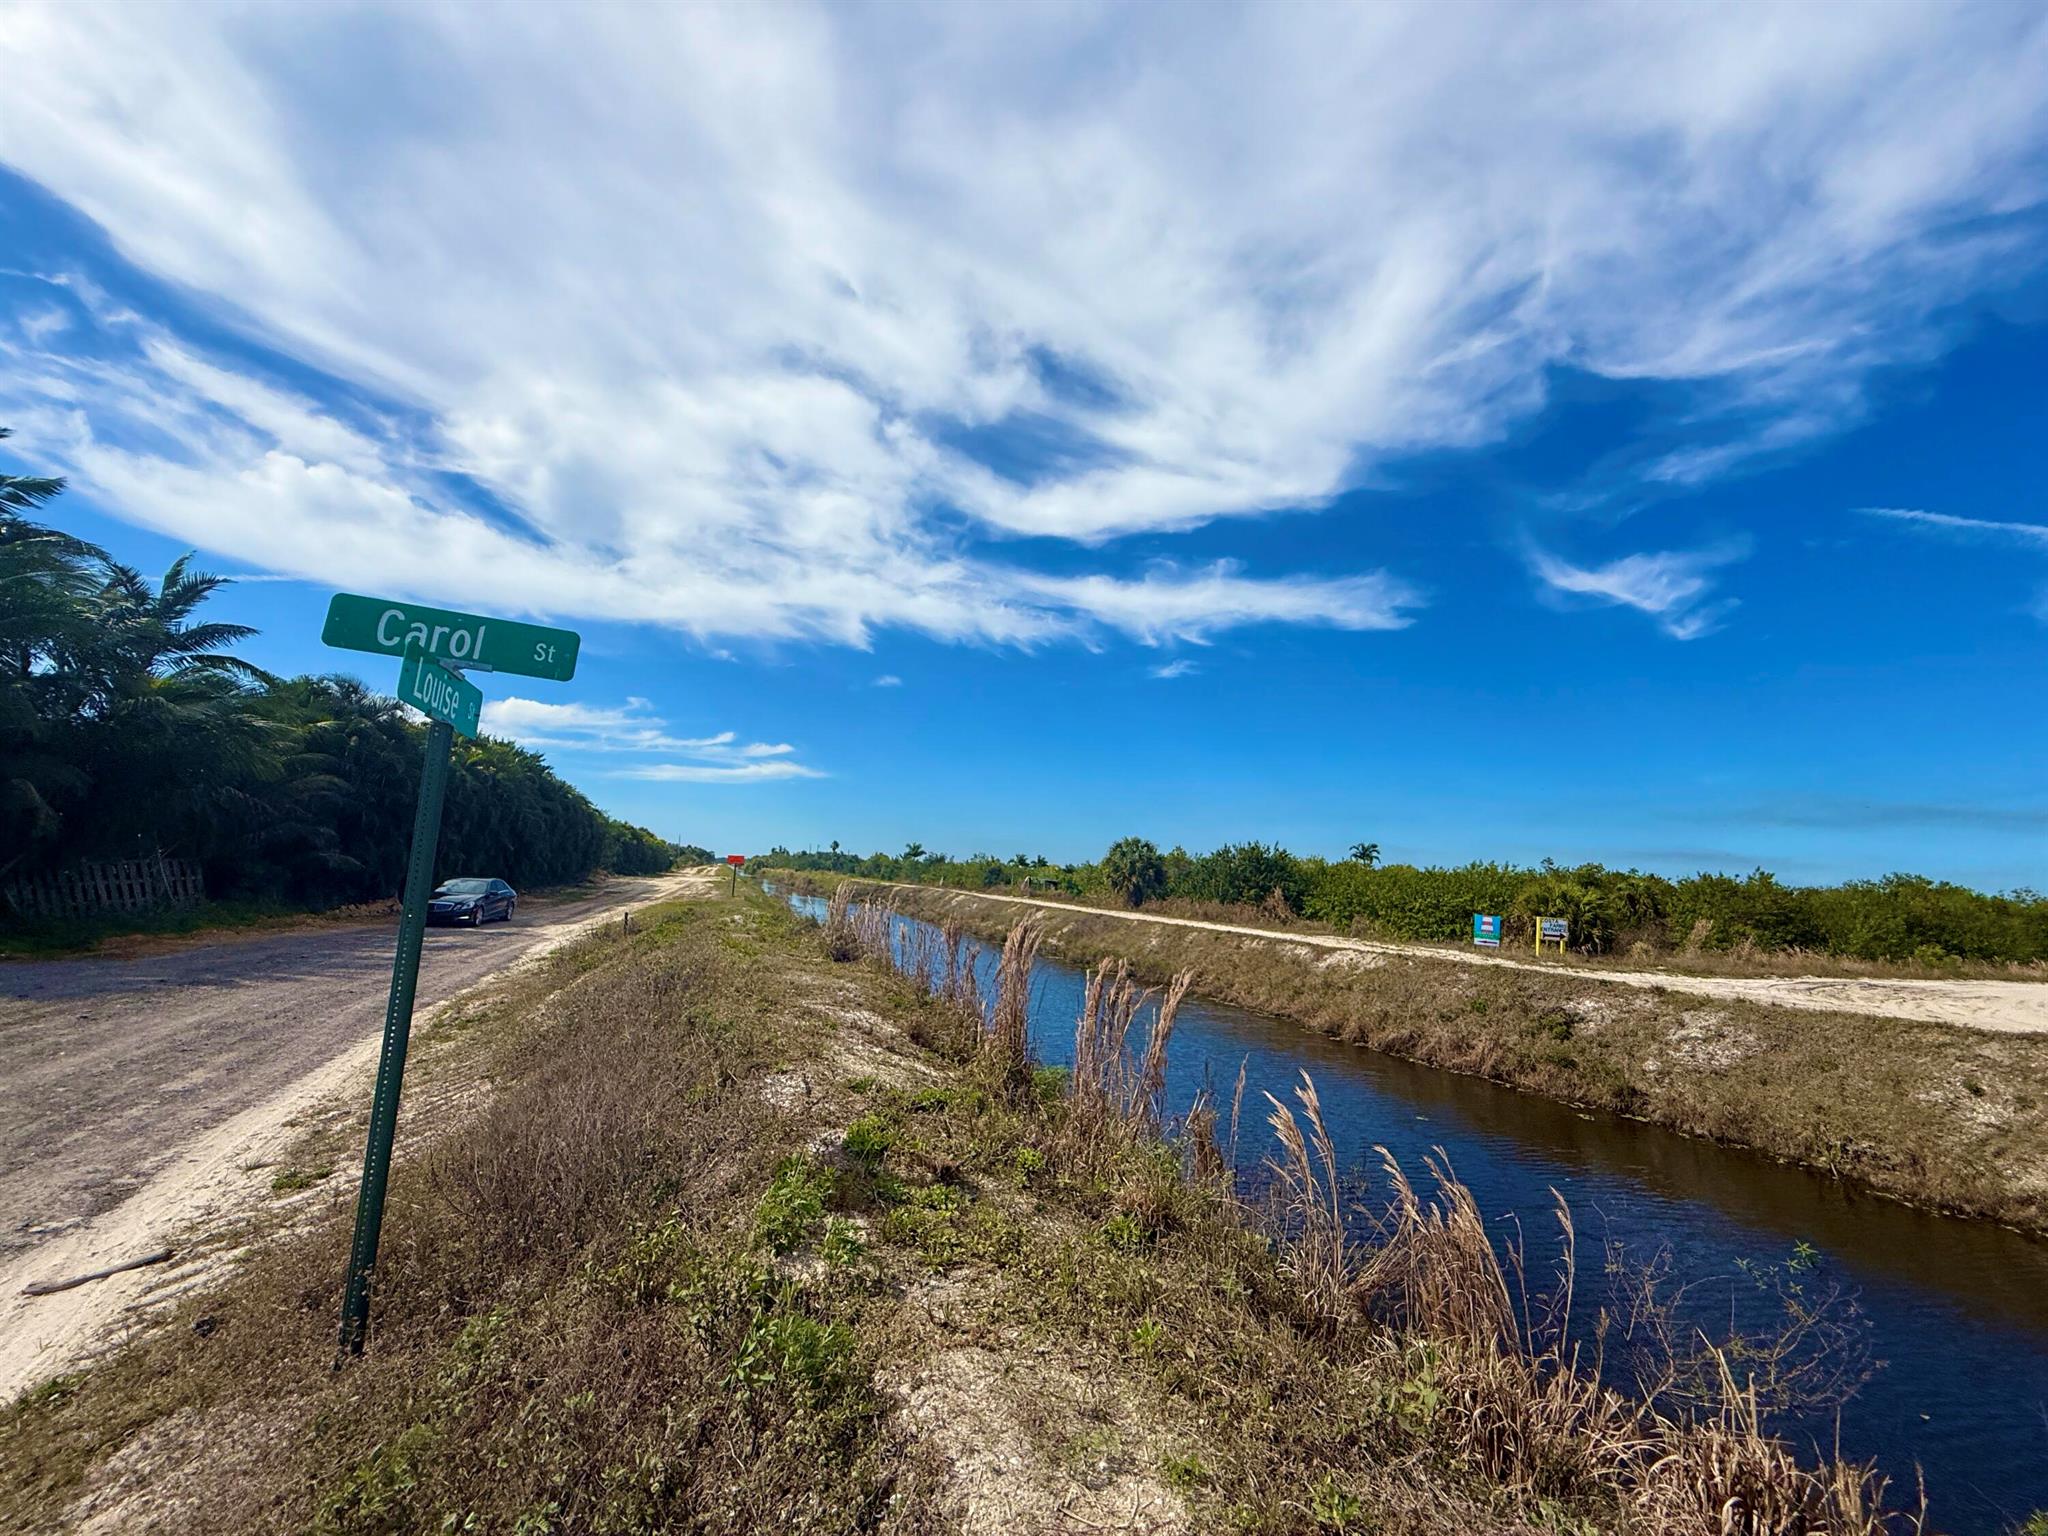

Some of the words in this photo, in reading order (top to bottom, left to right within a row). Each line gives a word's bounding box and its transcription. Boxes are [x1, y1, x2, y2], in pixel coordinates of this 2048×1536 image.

[377, 609, 486, 660] Carol
[533, 642, 556, 663] St
[413, 656, 459, 719] Louise
